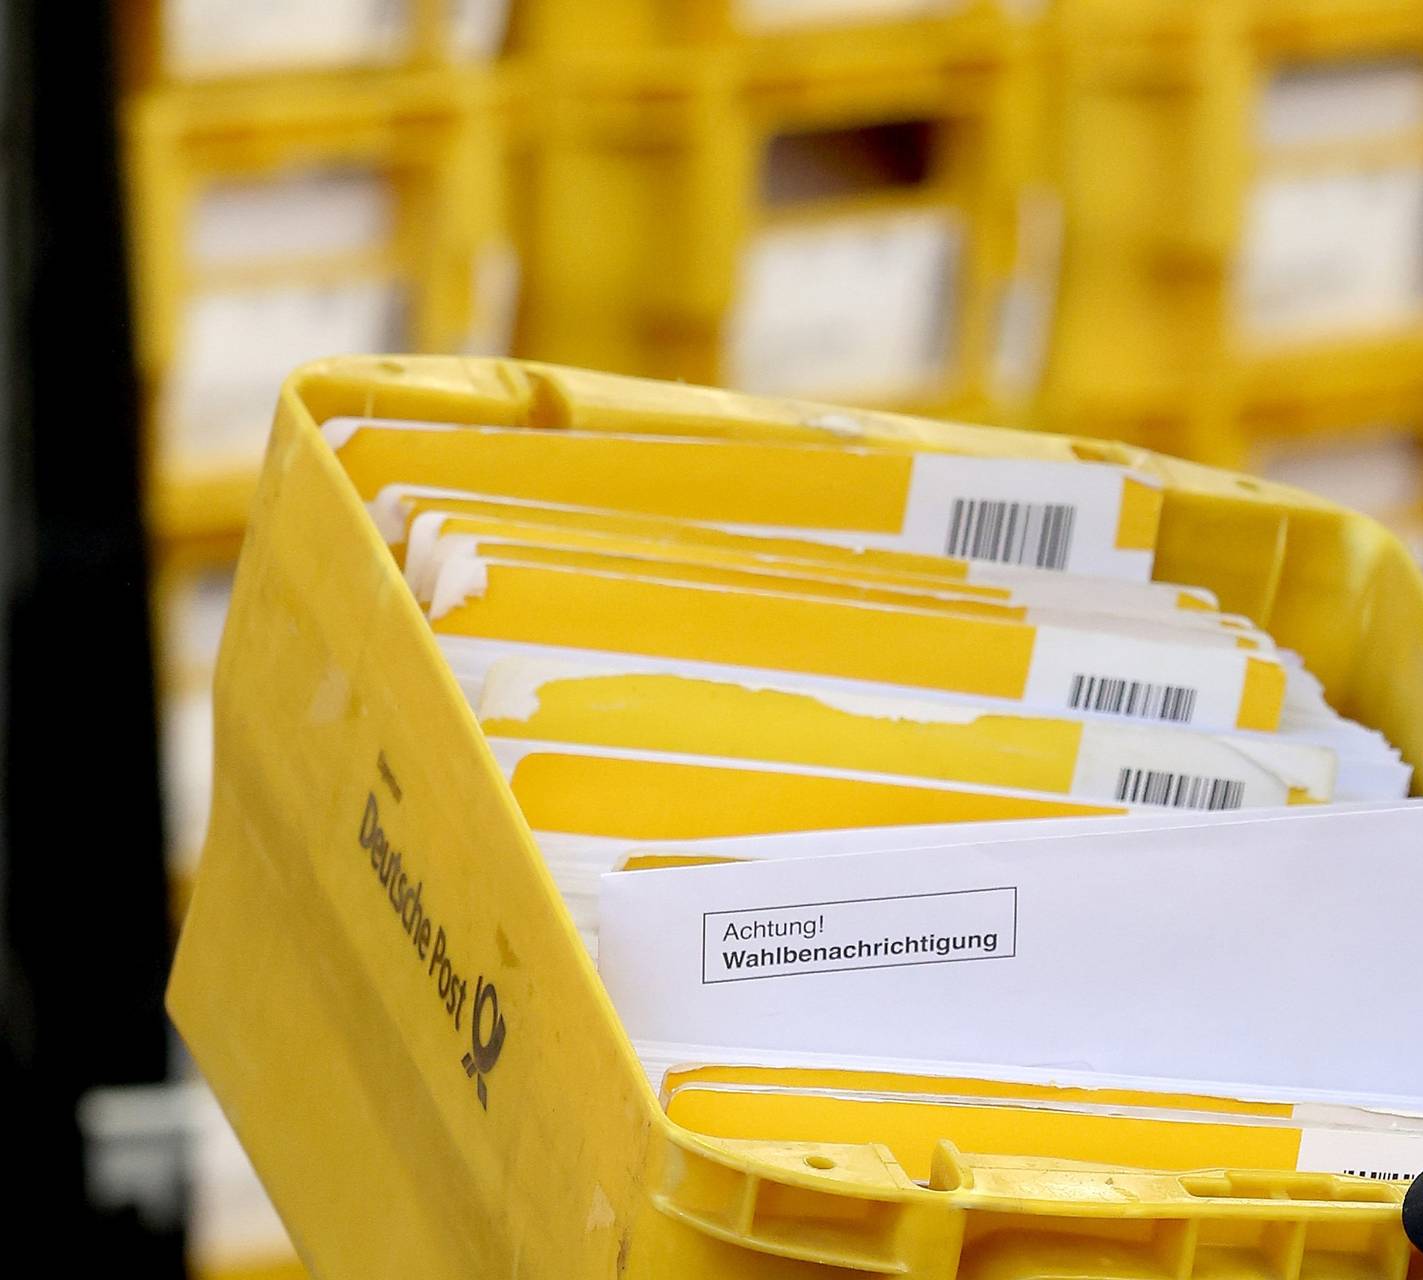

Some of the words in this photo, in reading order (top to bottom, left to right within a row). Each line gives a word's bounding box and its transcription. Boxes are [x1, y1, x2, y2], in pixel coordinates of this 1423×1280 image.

[358, 791, 432, 961] Deutsche
[428, 926, 467, 1032] Post
[722, 915, 825, 942] Achtung!
[722, 932, 998, 969] Wahlbenachrichtigung
